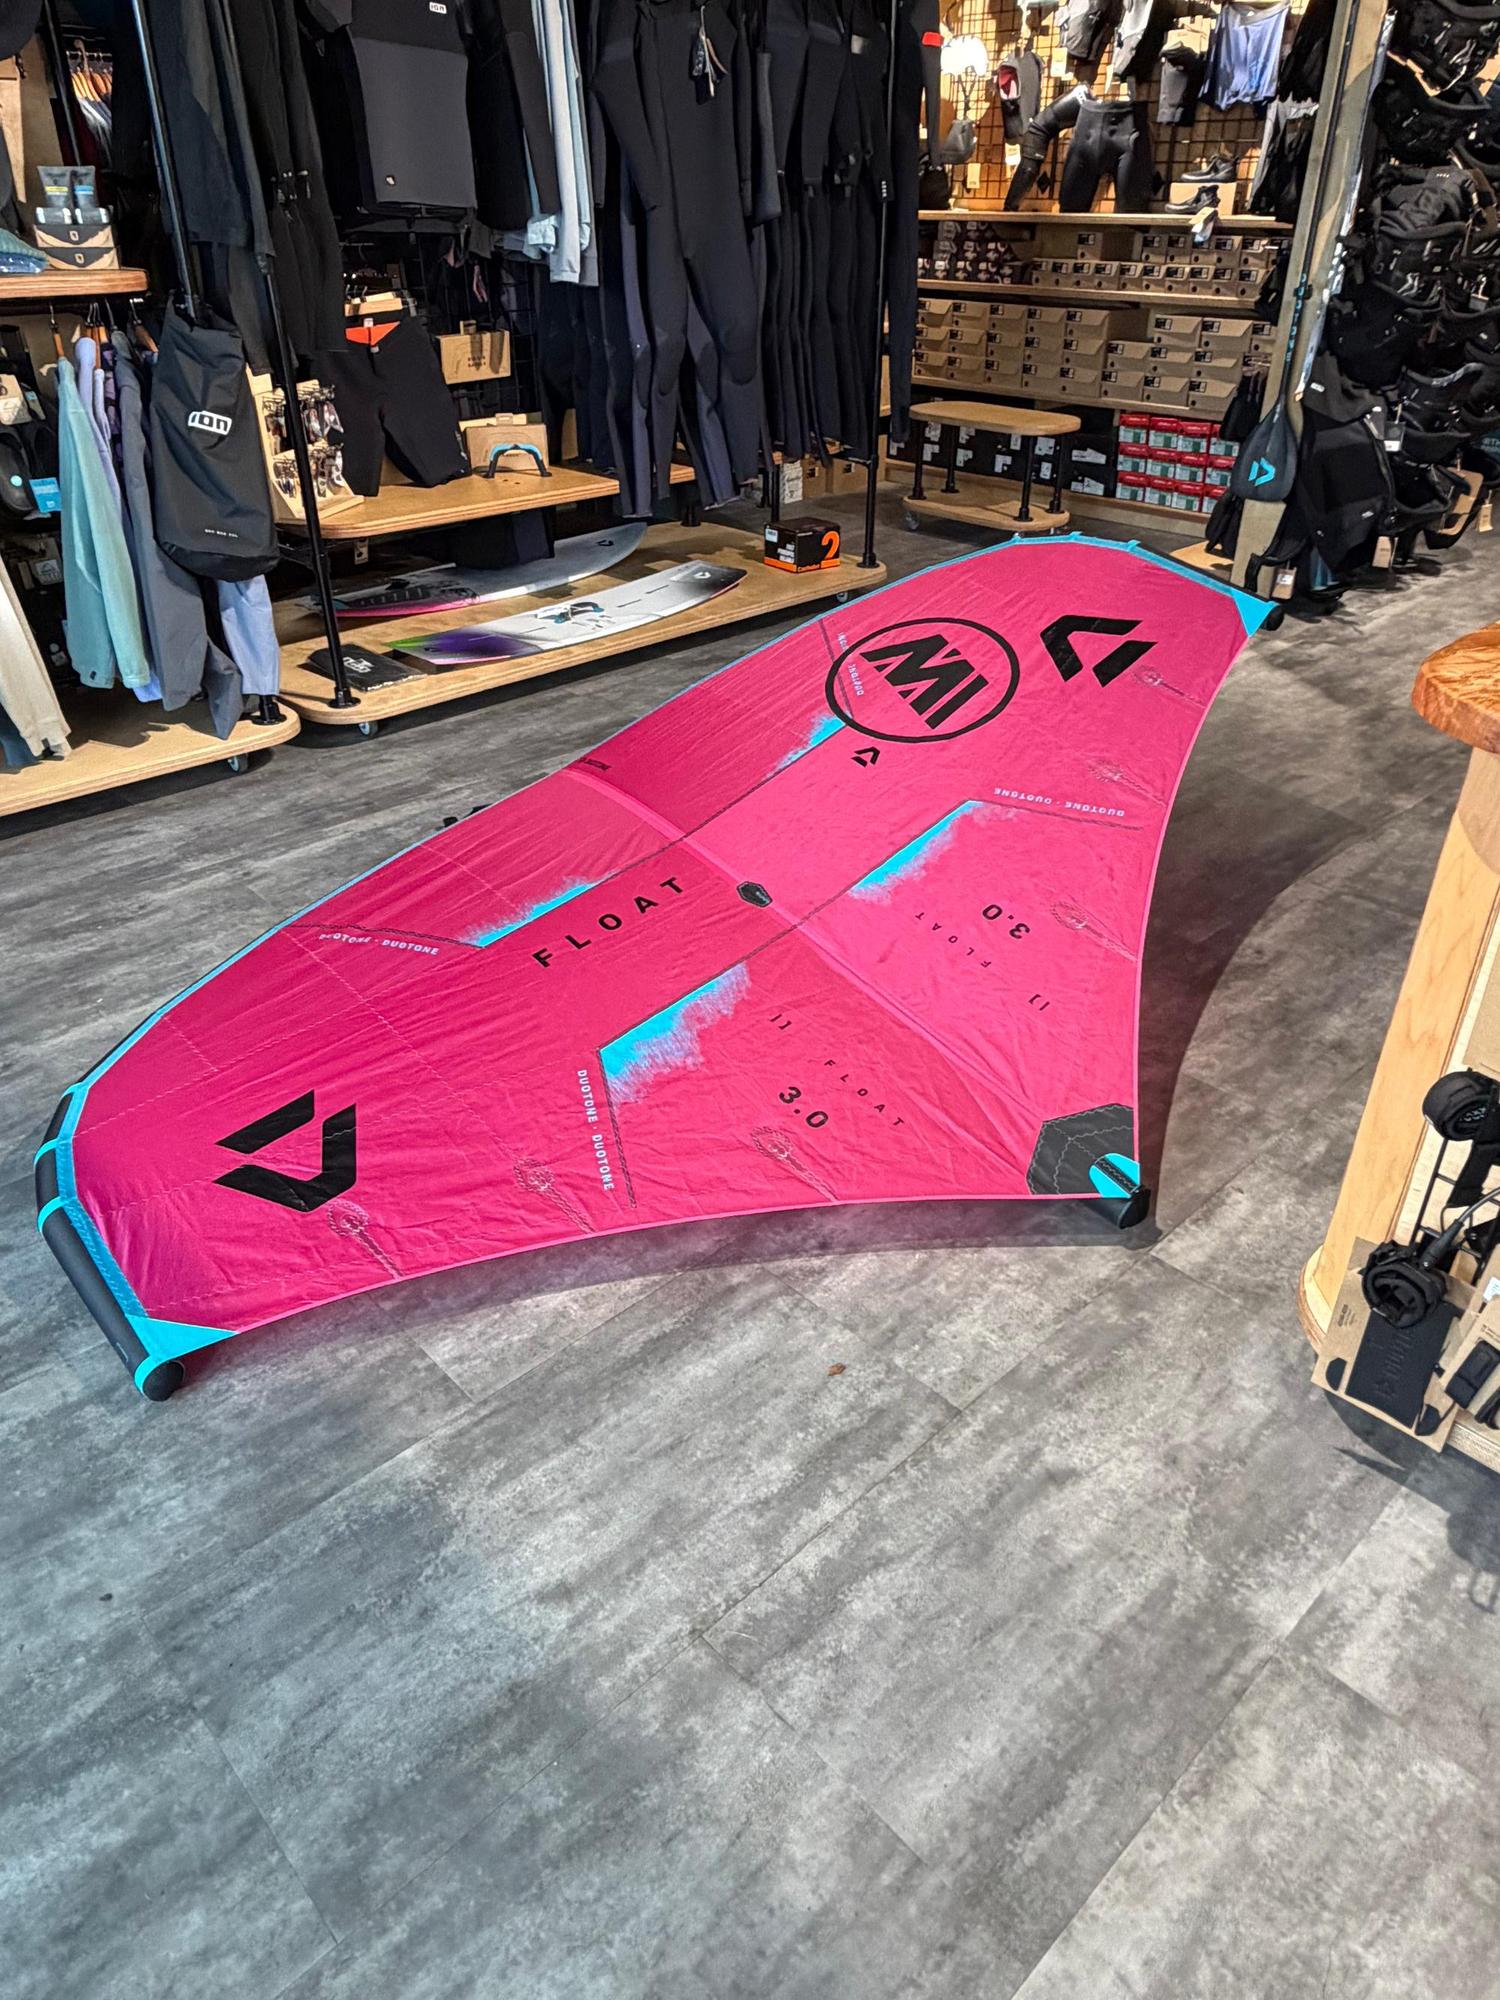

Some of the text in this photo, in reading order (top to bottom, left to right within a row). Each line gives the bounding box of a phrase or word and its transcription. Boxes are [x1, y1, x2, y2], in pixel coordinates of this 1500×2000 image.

[821, 531, 840, 568] 2
[993, 787, 1125, 817] DUOTONE DUOTONE
[532, 876, 684, 968] FLOAT
[915, 912, 992, 968] FLOAT
[982, 904, 1031, 939] 3.0
[382, 939, 440, 956] DUOTONE
[779, 1086, 829, 1128] 3.0
[824, 1059, 904, 1126] FLOAT
[577, 1069, 615, 1191] DUOTONE DUOTONE
